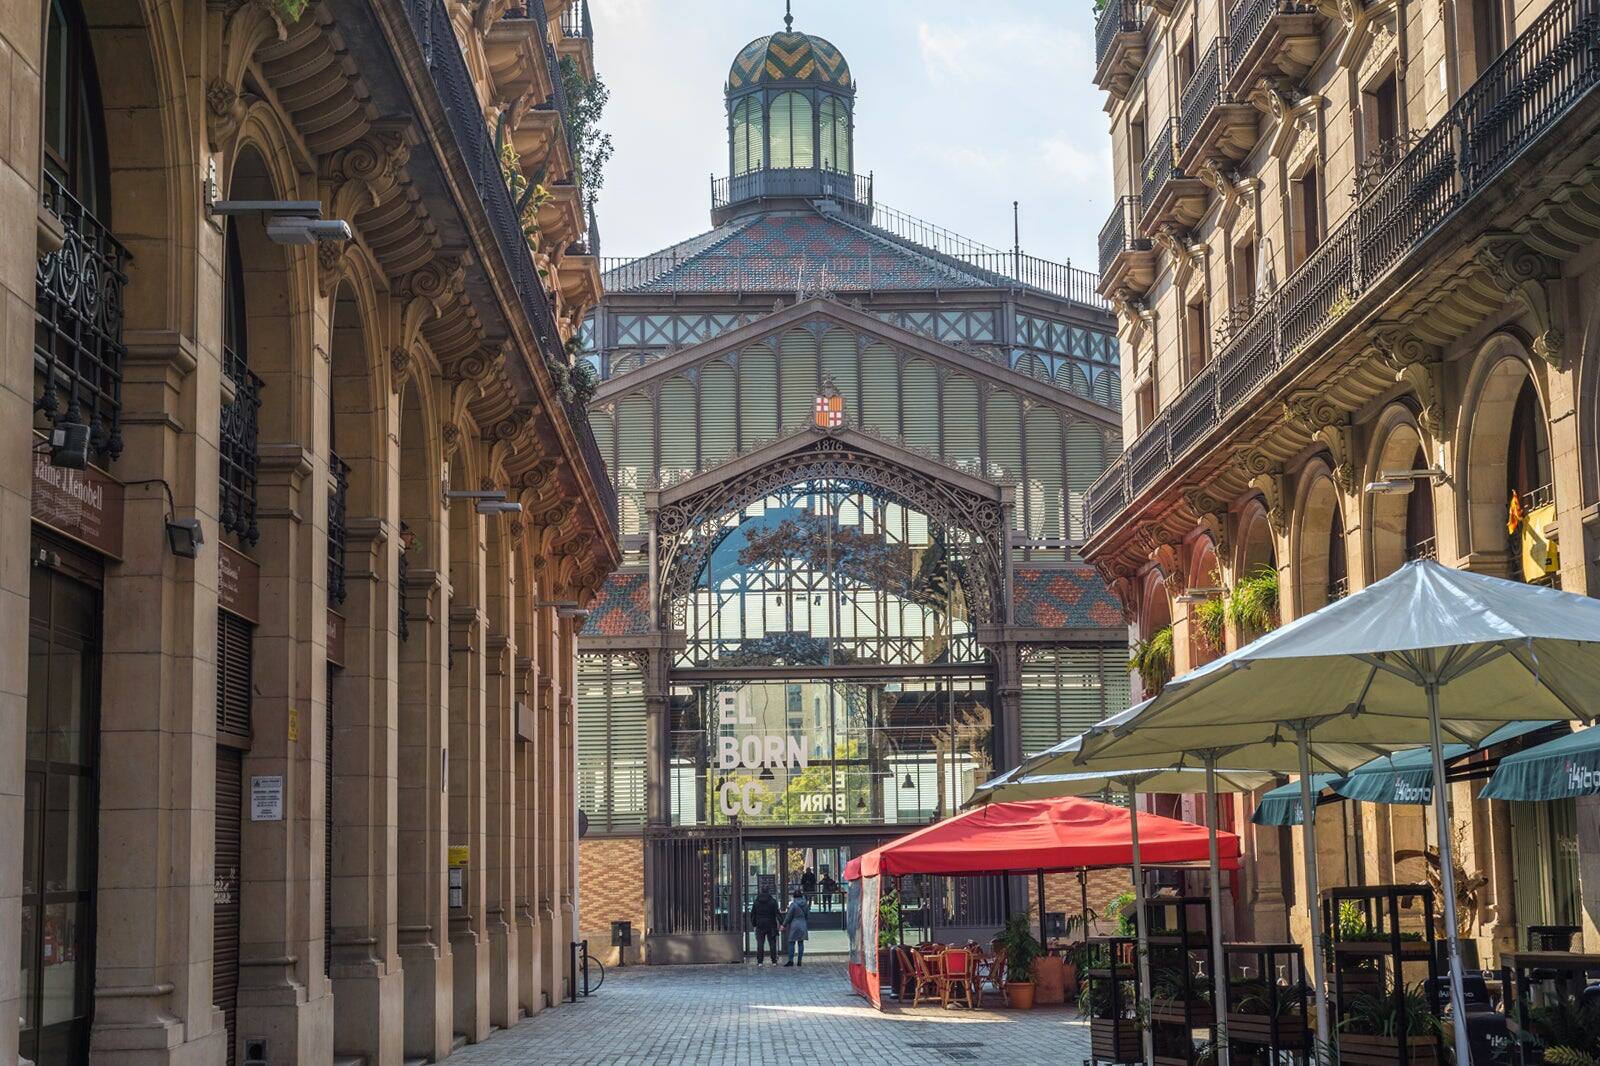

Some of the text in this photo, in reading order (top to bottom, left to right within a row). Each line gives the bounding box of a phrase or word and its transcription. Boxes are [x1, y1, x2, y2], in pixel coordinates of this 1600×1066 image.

[815, 440, 843, 450] 1876
[35, 446, 61, 489] Jaime
[719, 691, 756, 724] EL
[719, 735, 808, 769] BORN
[720, 781, 762, 816] CC
